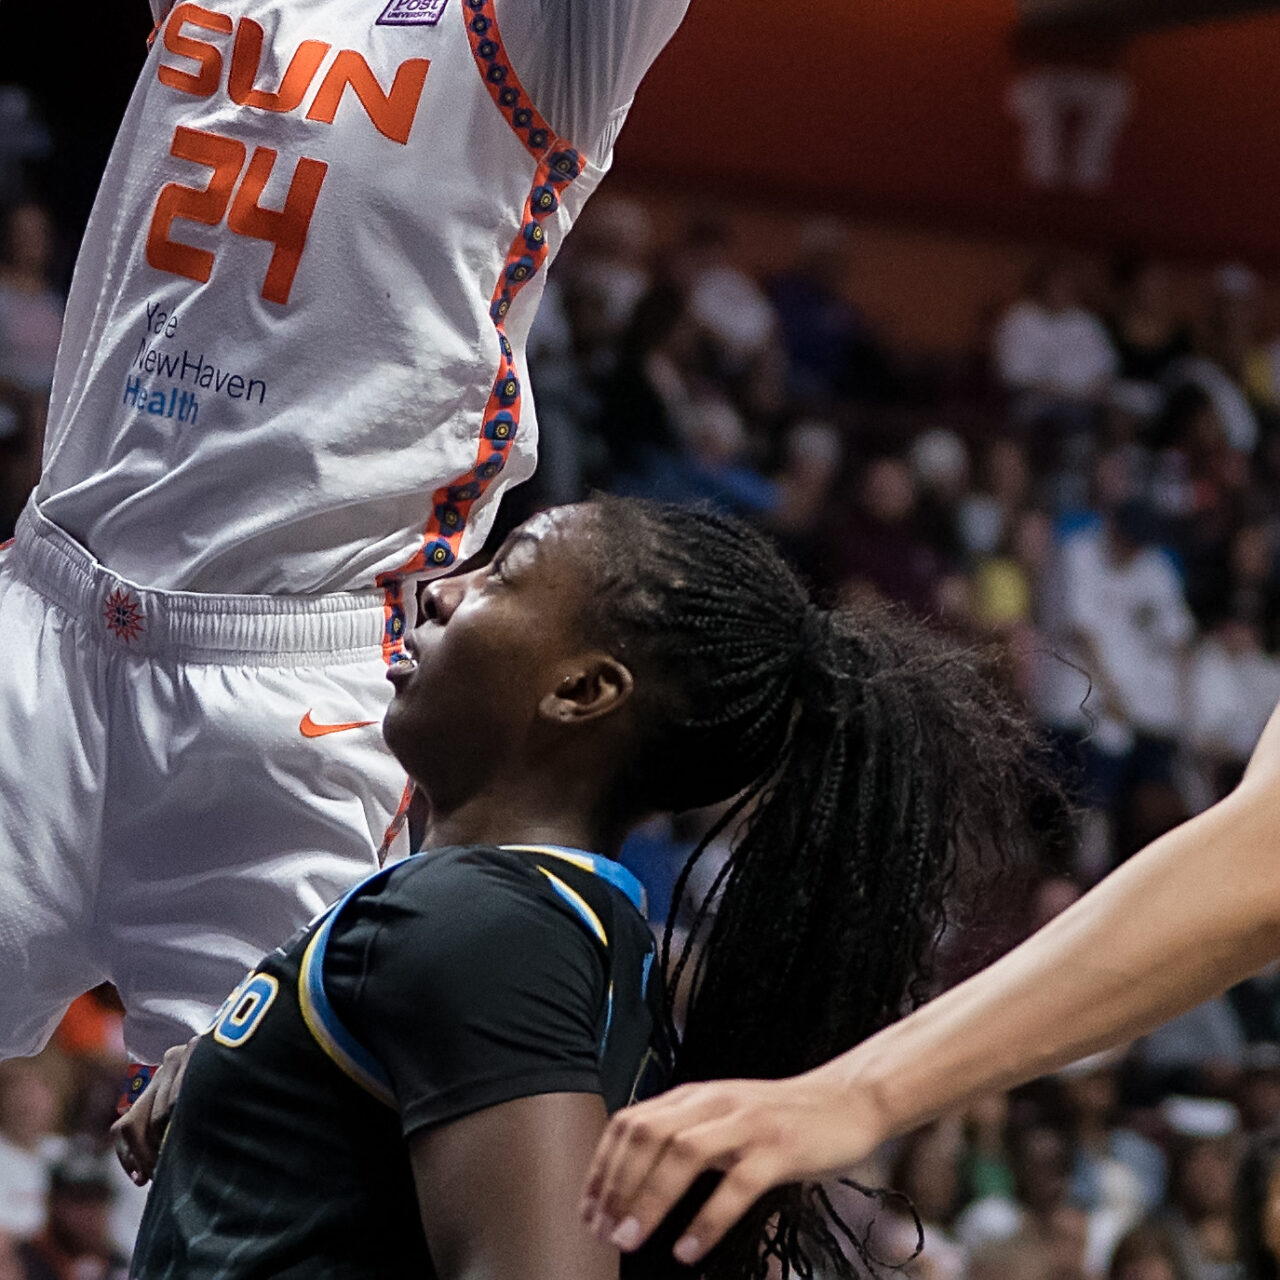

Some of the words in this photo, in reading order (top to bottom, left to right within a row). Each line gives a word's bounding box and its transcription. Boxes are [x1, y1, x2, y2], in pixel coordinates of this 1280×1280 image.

[157, 2, 431, 145] SUN
[145, 125, 328, 305] 24
[146, 301, 178, 338] Yae
[123, 375, 199, 425] Health
